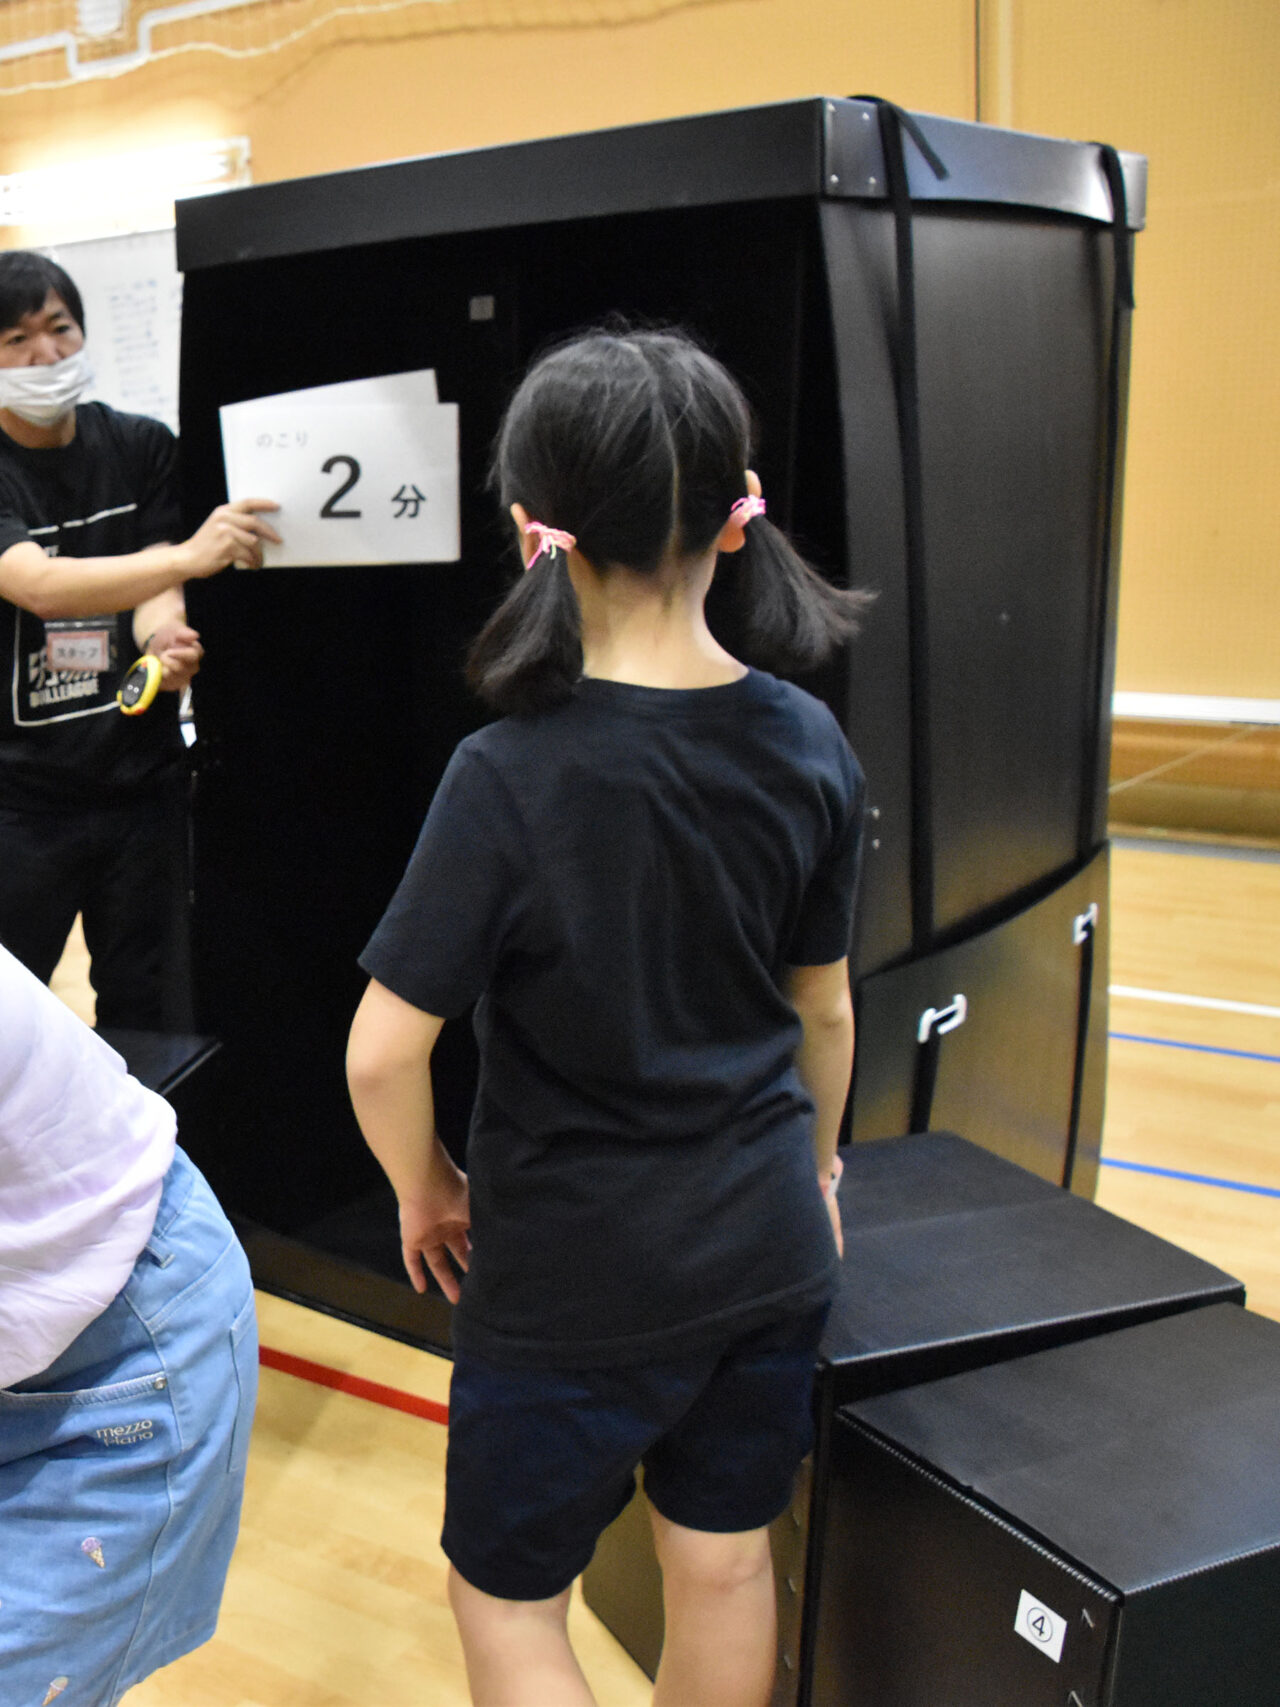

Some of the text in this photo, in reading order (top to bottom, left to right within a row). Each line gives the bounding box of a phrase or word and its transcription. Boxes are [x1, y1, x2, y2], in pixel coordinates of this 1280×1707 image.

[256, 430, 308, 448] のこり
[320, 454, 426, 519] 2 分
[57, 647, 98, 658] スタッフ
[96, 1420, 153, 1439] mezzo
